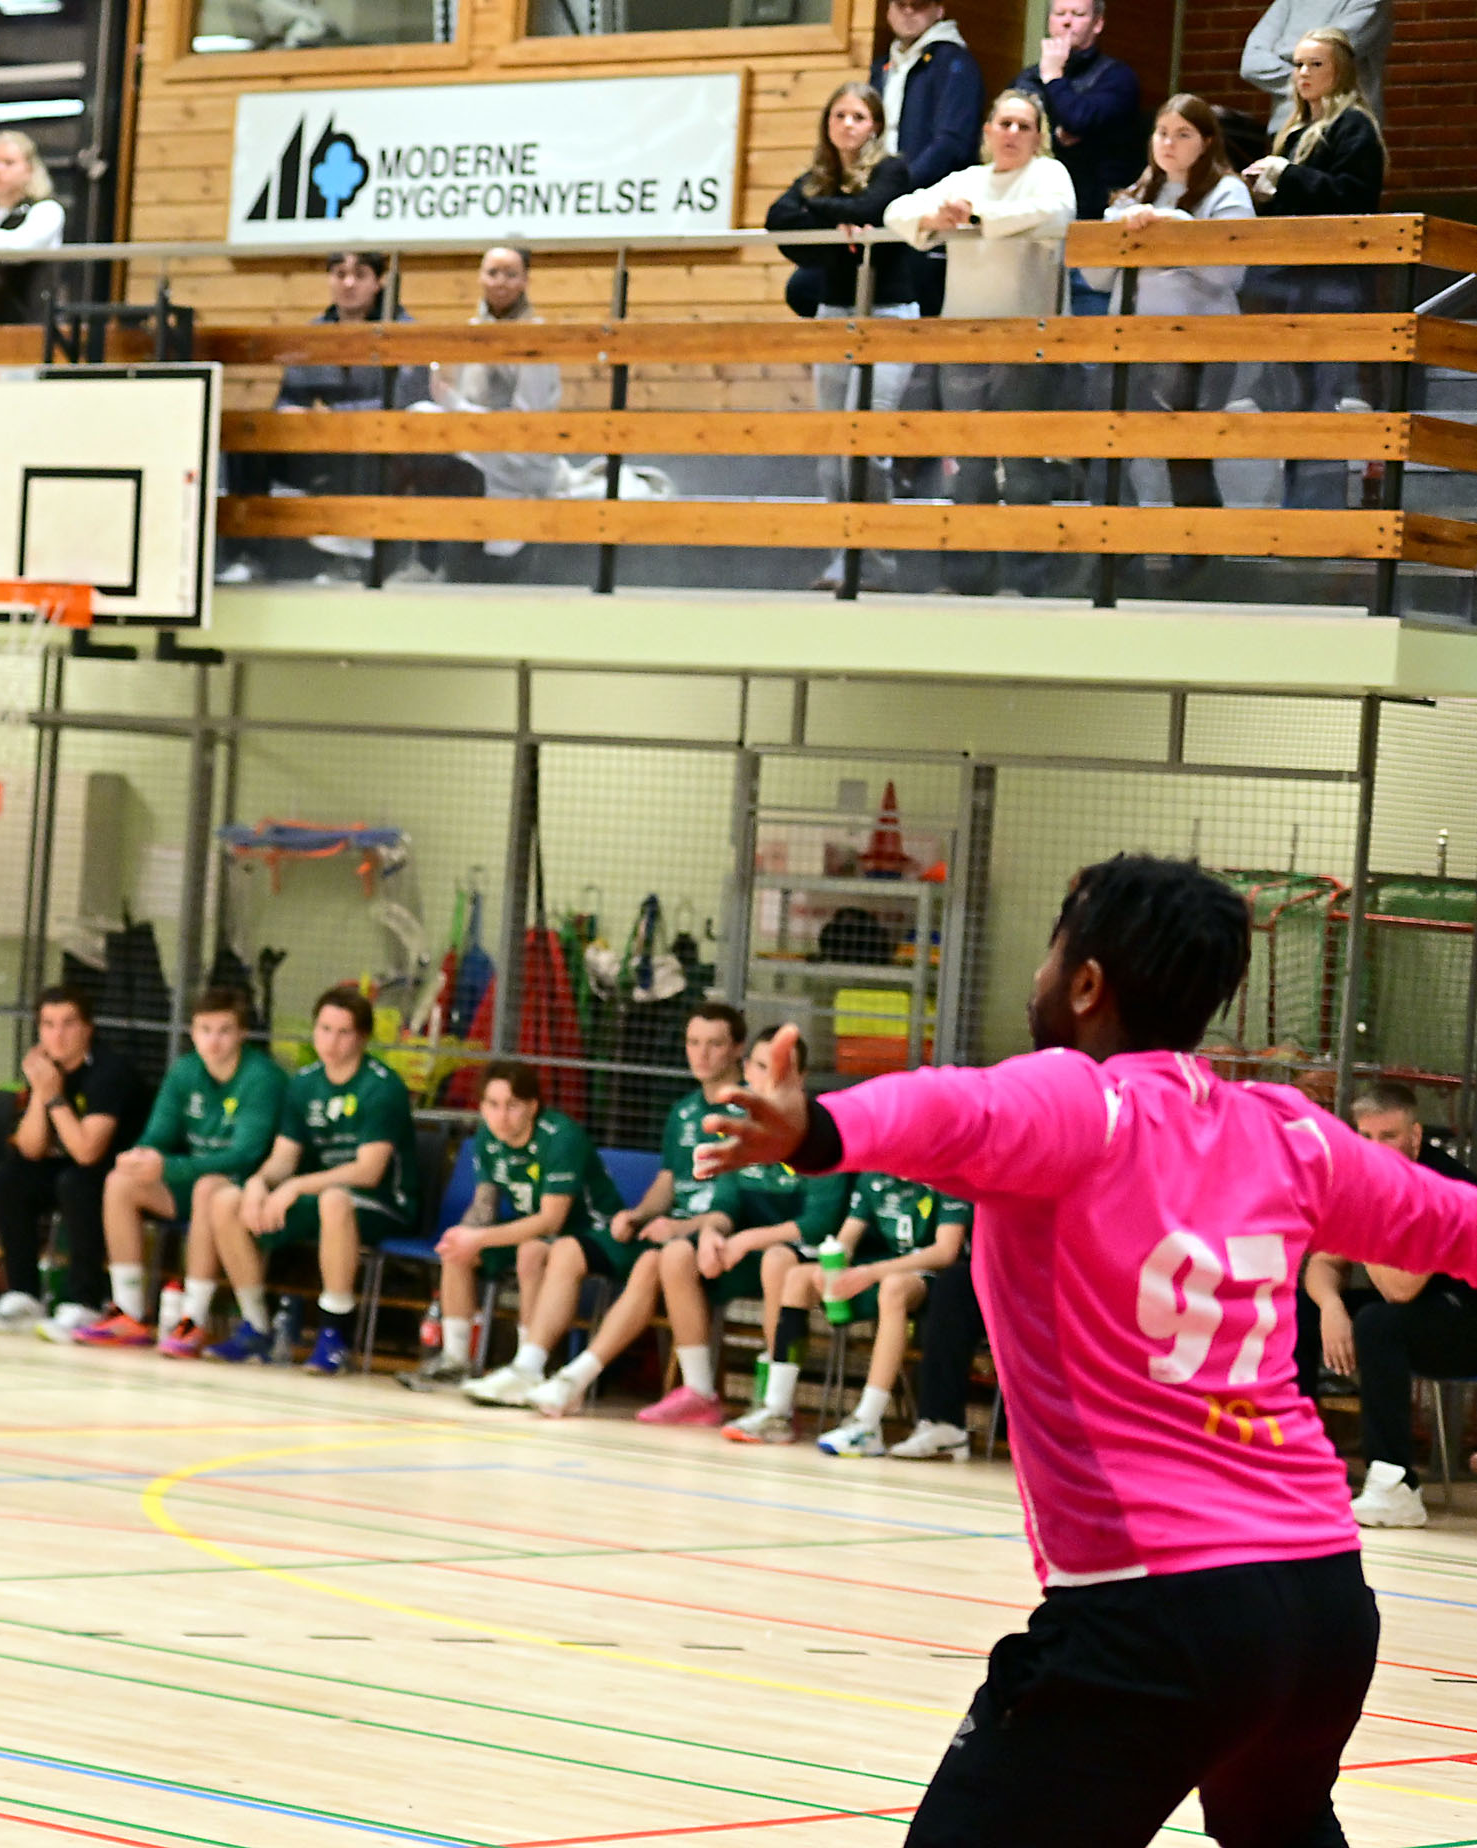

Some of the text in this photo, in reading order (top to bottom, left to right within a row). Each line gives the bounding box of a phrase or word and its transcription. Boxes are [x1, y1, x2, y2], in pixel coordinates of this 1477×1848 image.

[377, 142, 539, 179] MODERNE
[373, 176, 719, 219] BYGGFORNYELSE AS
[1136, 1231, 1287, 1386] 97
